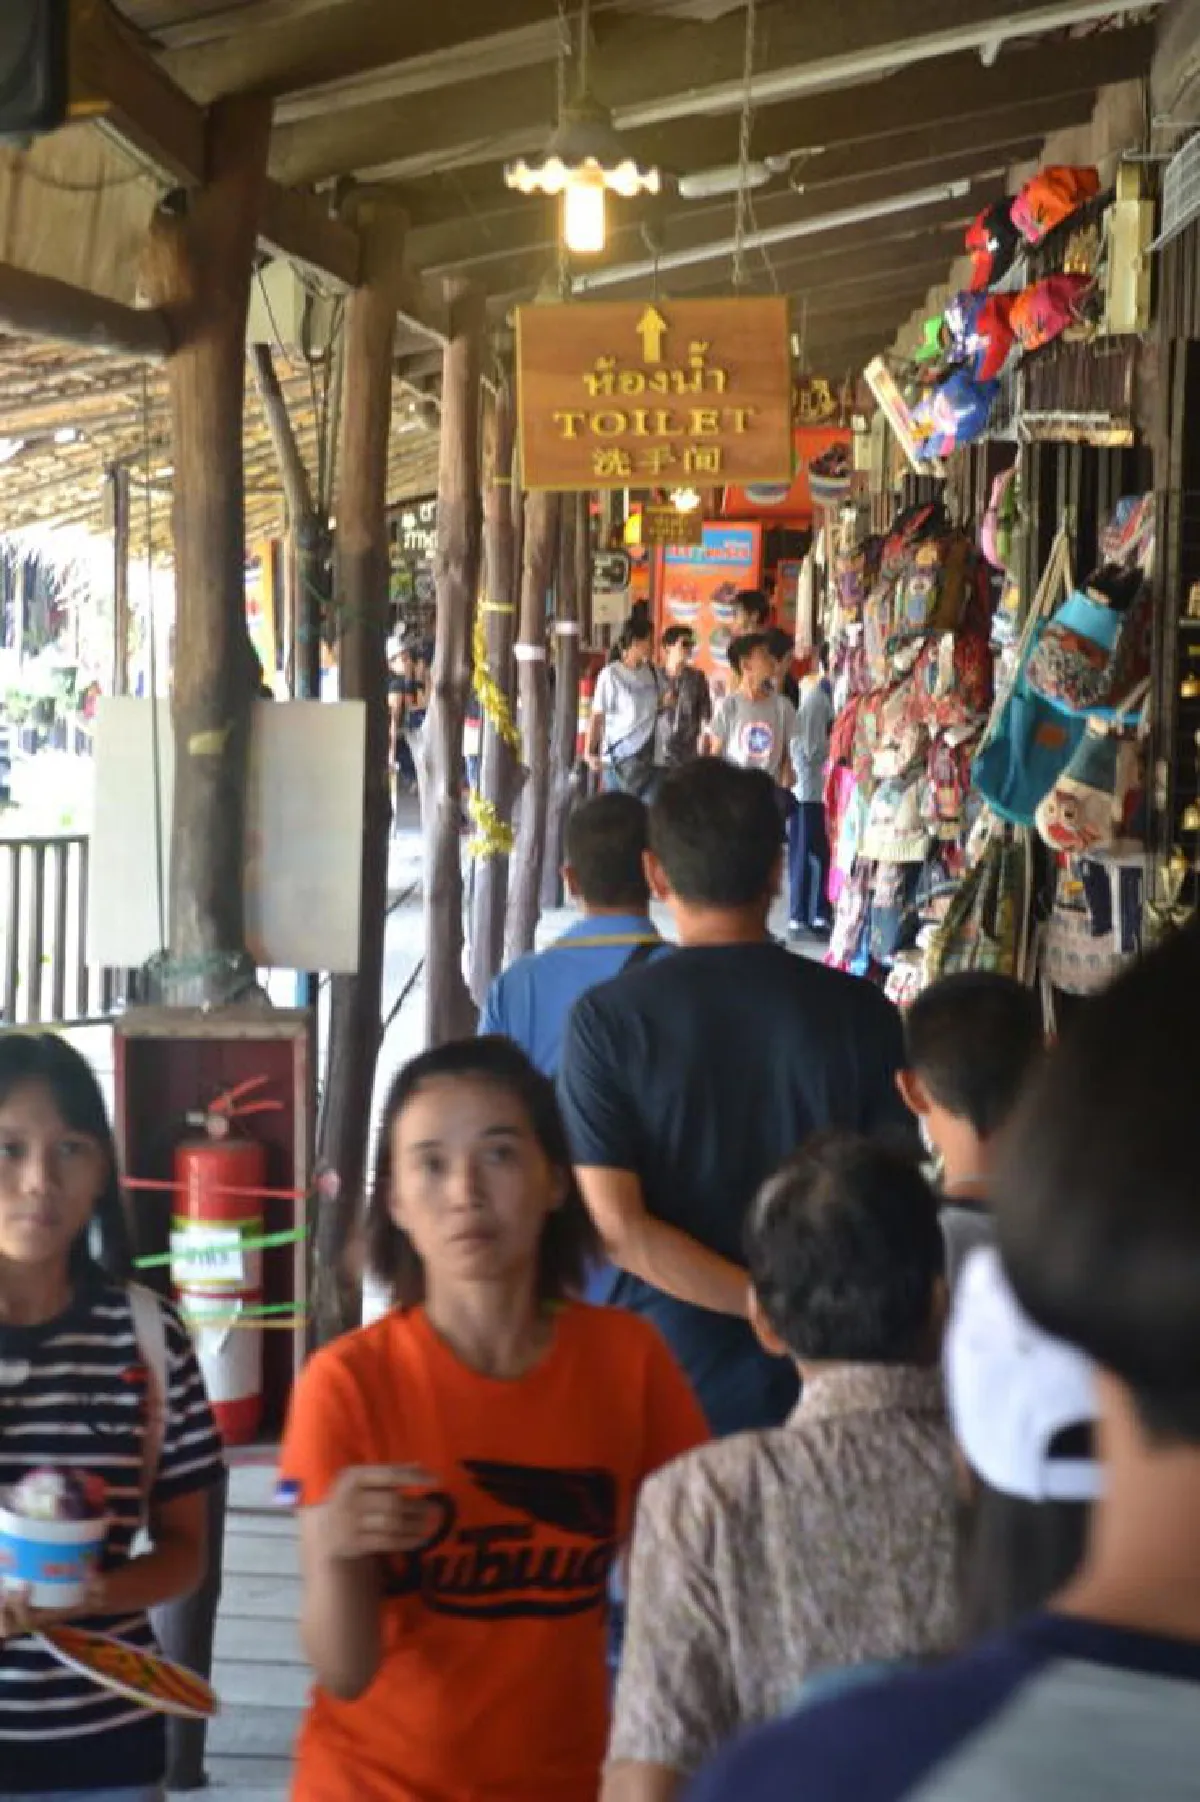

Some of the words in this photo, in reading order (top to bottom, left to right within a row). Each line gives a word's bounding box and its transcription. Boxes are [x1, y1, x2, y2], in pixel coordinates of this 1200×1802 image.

[582, 340, 729, 397] ห้องน้ำ
[553, 407, 757, 440] TOILET
[592, 442, 723, 478] 洗手间
